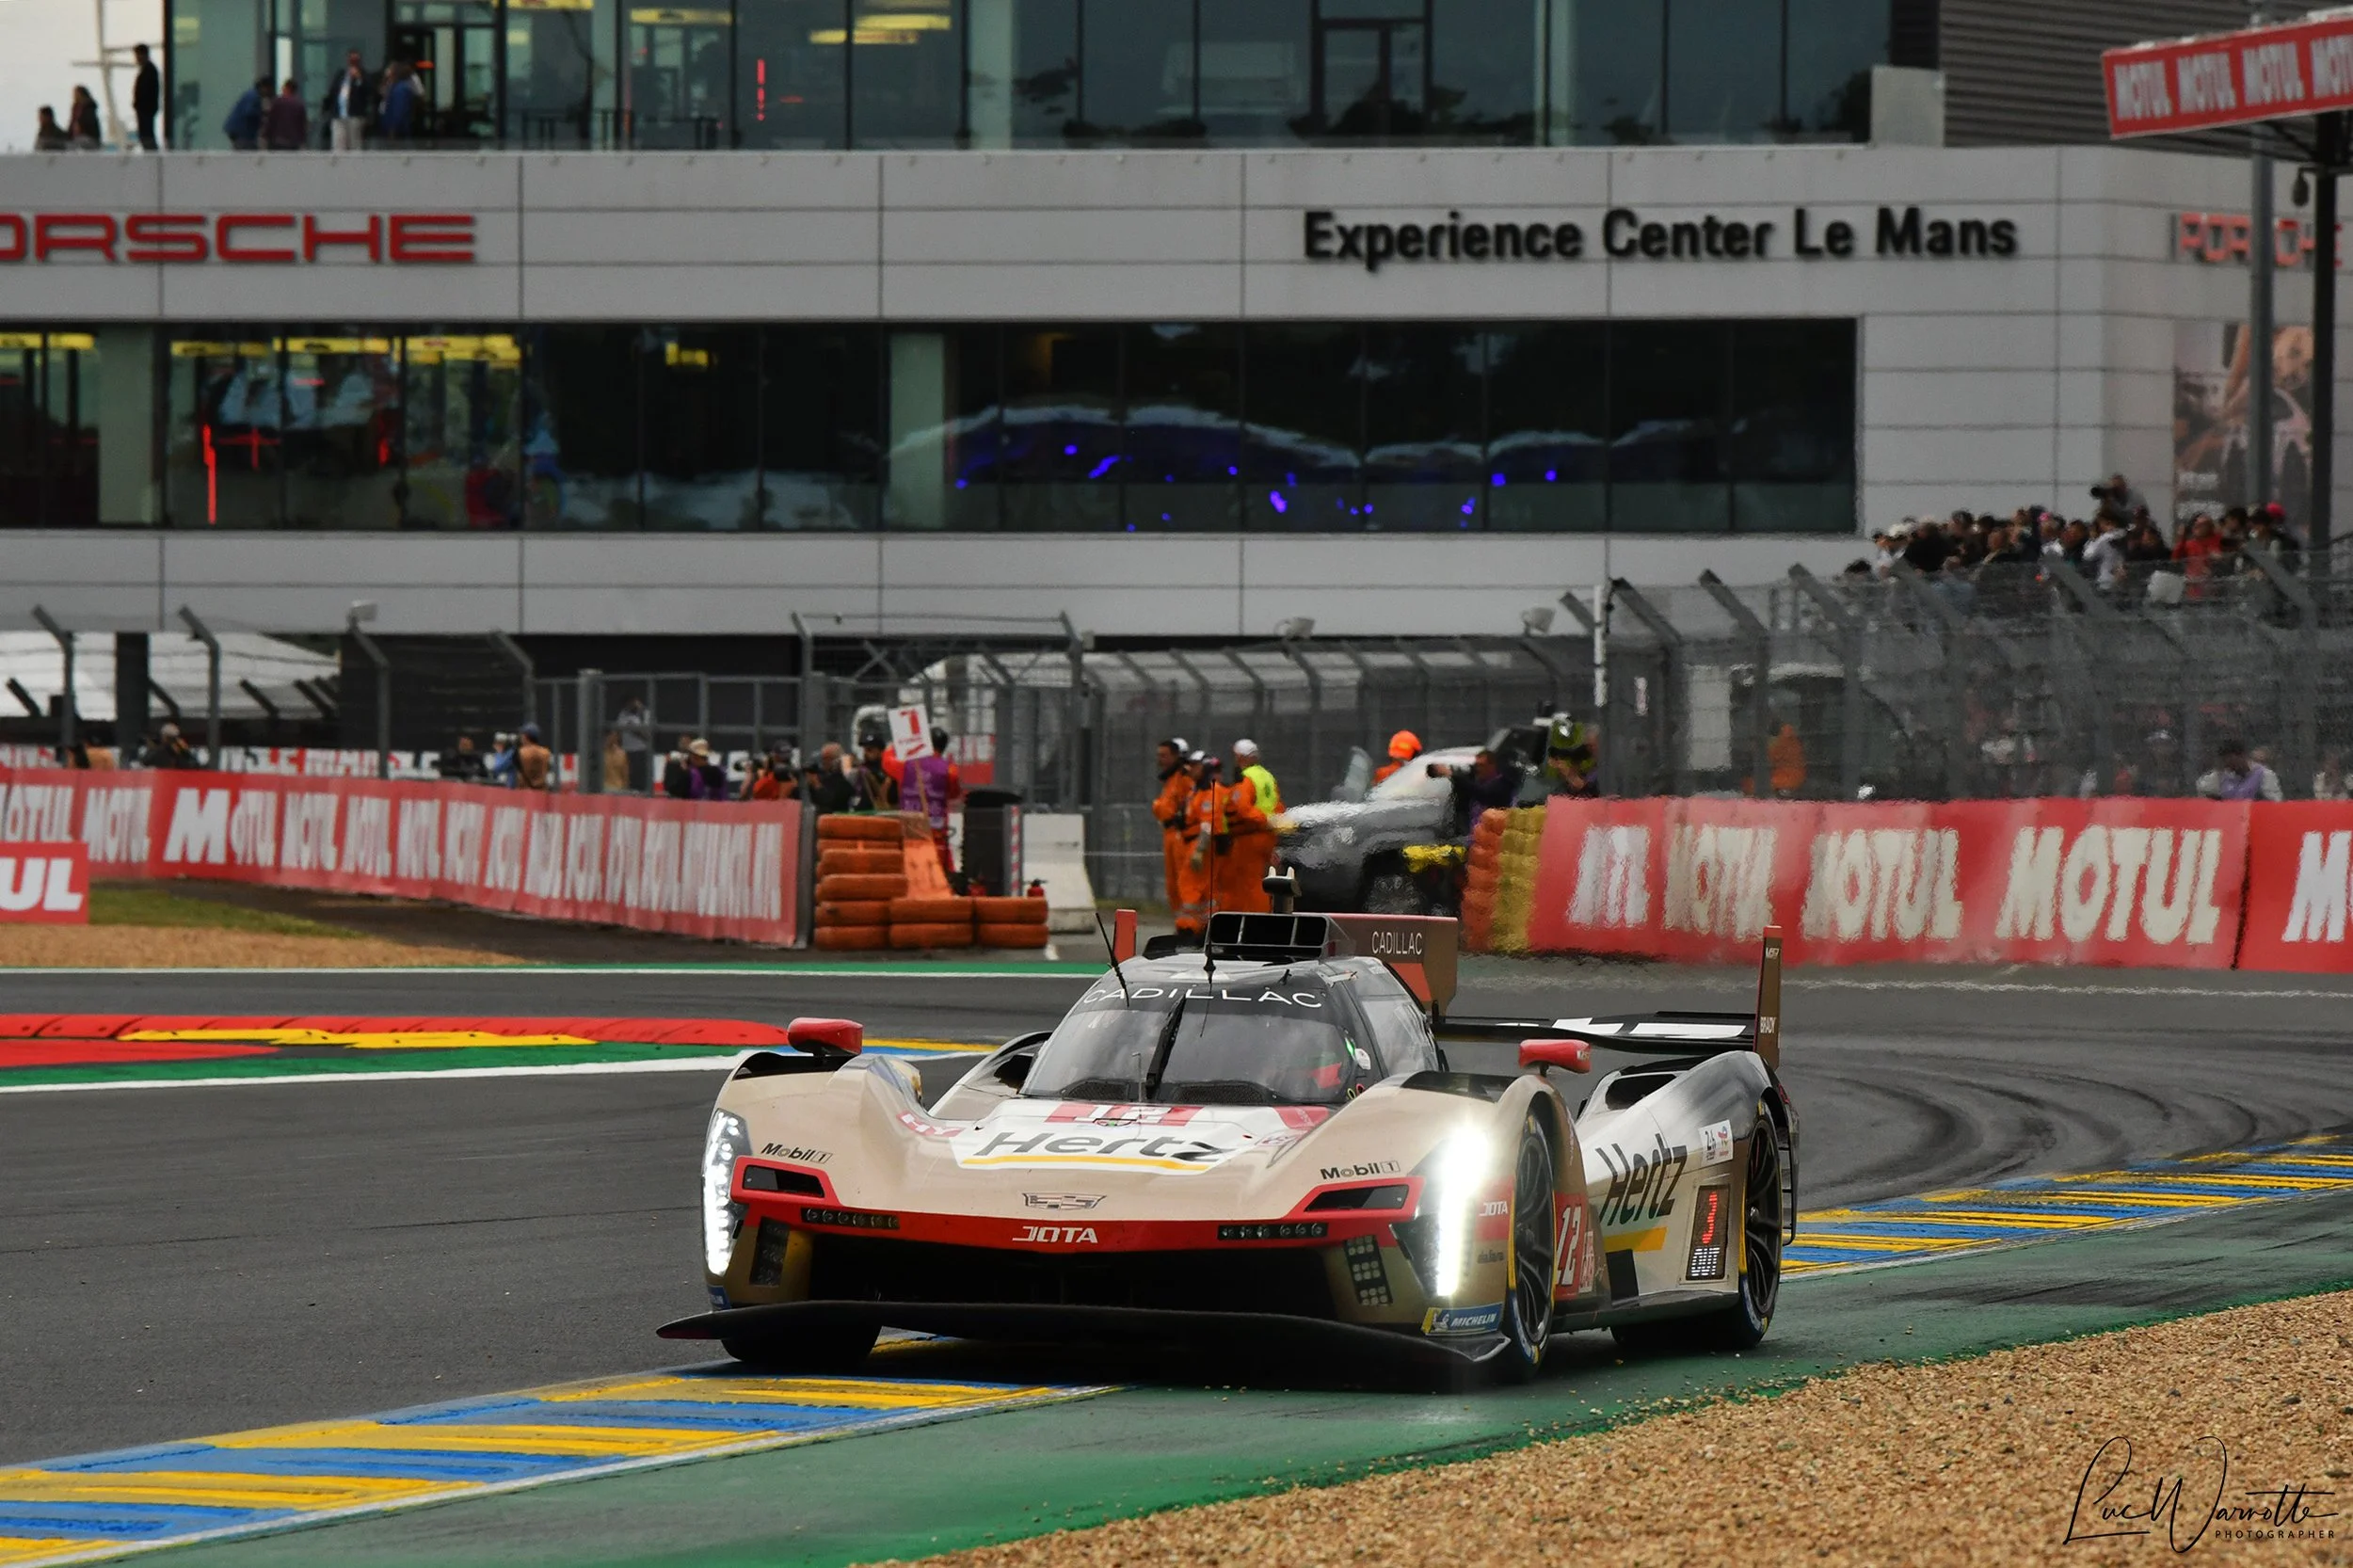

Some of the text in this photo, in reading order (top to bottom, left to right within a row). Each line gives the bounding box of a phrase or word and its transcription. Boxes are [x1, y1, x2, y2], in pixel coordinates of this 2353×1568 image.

[1304, 204, 2019, 274] Experience Center Le Mans
[0, 782, 74, 842] OTUL
[1801, 827, 1963, 942] MOTUL
[1994, 824, 2222, 945] MOTUL
[1371, 931, 1423, 955] CADILLAC
[1083, 987, 1322, 1009] CADILLAC
[760, 1143, 816, 1161] Mobil
[973, 1130, 1235, 1163] Hertz
[1320, 1162, 1381, 1180] Mobil
[1595, 1132, 1688, 1226] Hertz
[1479, 1201, 1509, 1217] JOTA
[1012, 1225, 1098, 1243] JOTA
[1556, 1206, 1582, 1286] 12
[1450, 1312, 1497, 1327] MICHELIN
